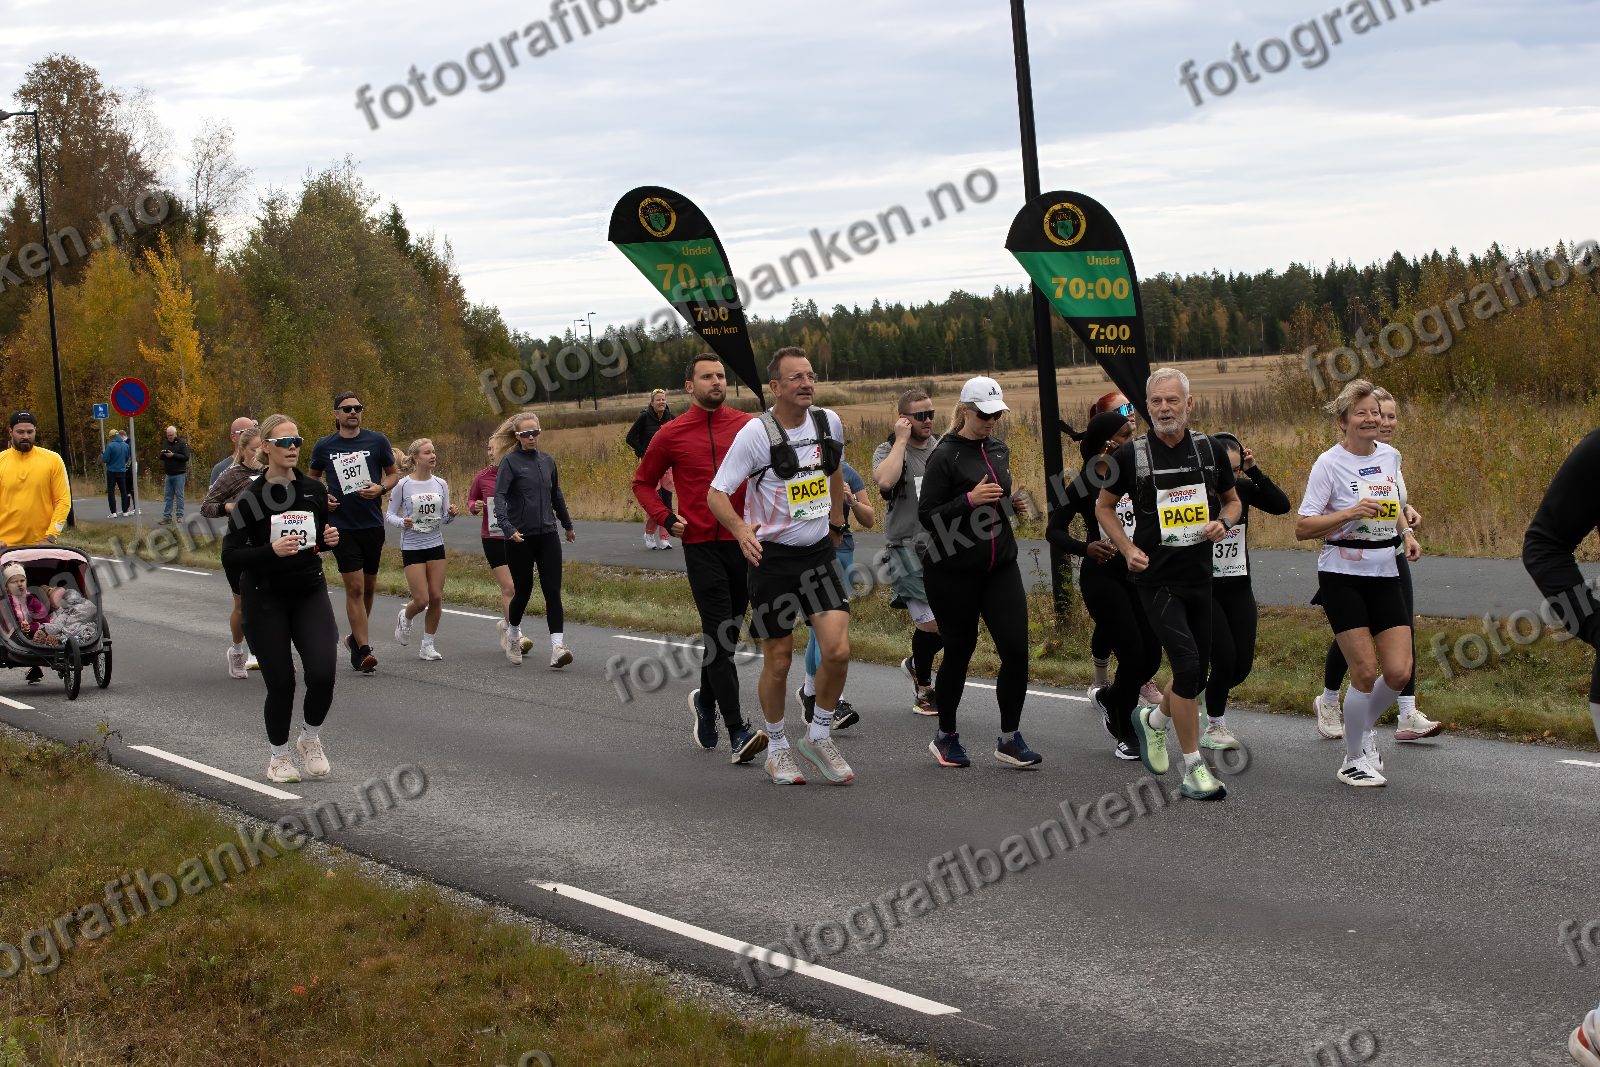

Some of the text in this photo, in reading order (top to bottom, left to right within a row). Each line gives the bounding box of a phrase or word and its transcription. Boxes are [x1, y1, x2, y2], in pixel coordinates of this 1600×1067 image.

[681, 246, 712, 256] Under
[1087, 255, 1120, 266] Under
[656, 263, 696, 291] 70
[1052, 277, 1129, 300] 70:00
[694, 306, 729, 321] 7:00
[702, 325, 739, 336] min/km
[1087, 323, 1130, 341] 7:00
[1095, 345, 1136, 356] min/km
[342, 464, 362, 480] 387
[790, 478, 827, 501] PACE
[1168, 488, 1197, 498] NORGES
[418, 503, 435, 514] 403
[1163, 506, 1205, 526] PACE
[1214, 542, 1239, 558] 375
